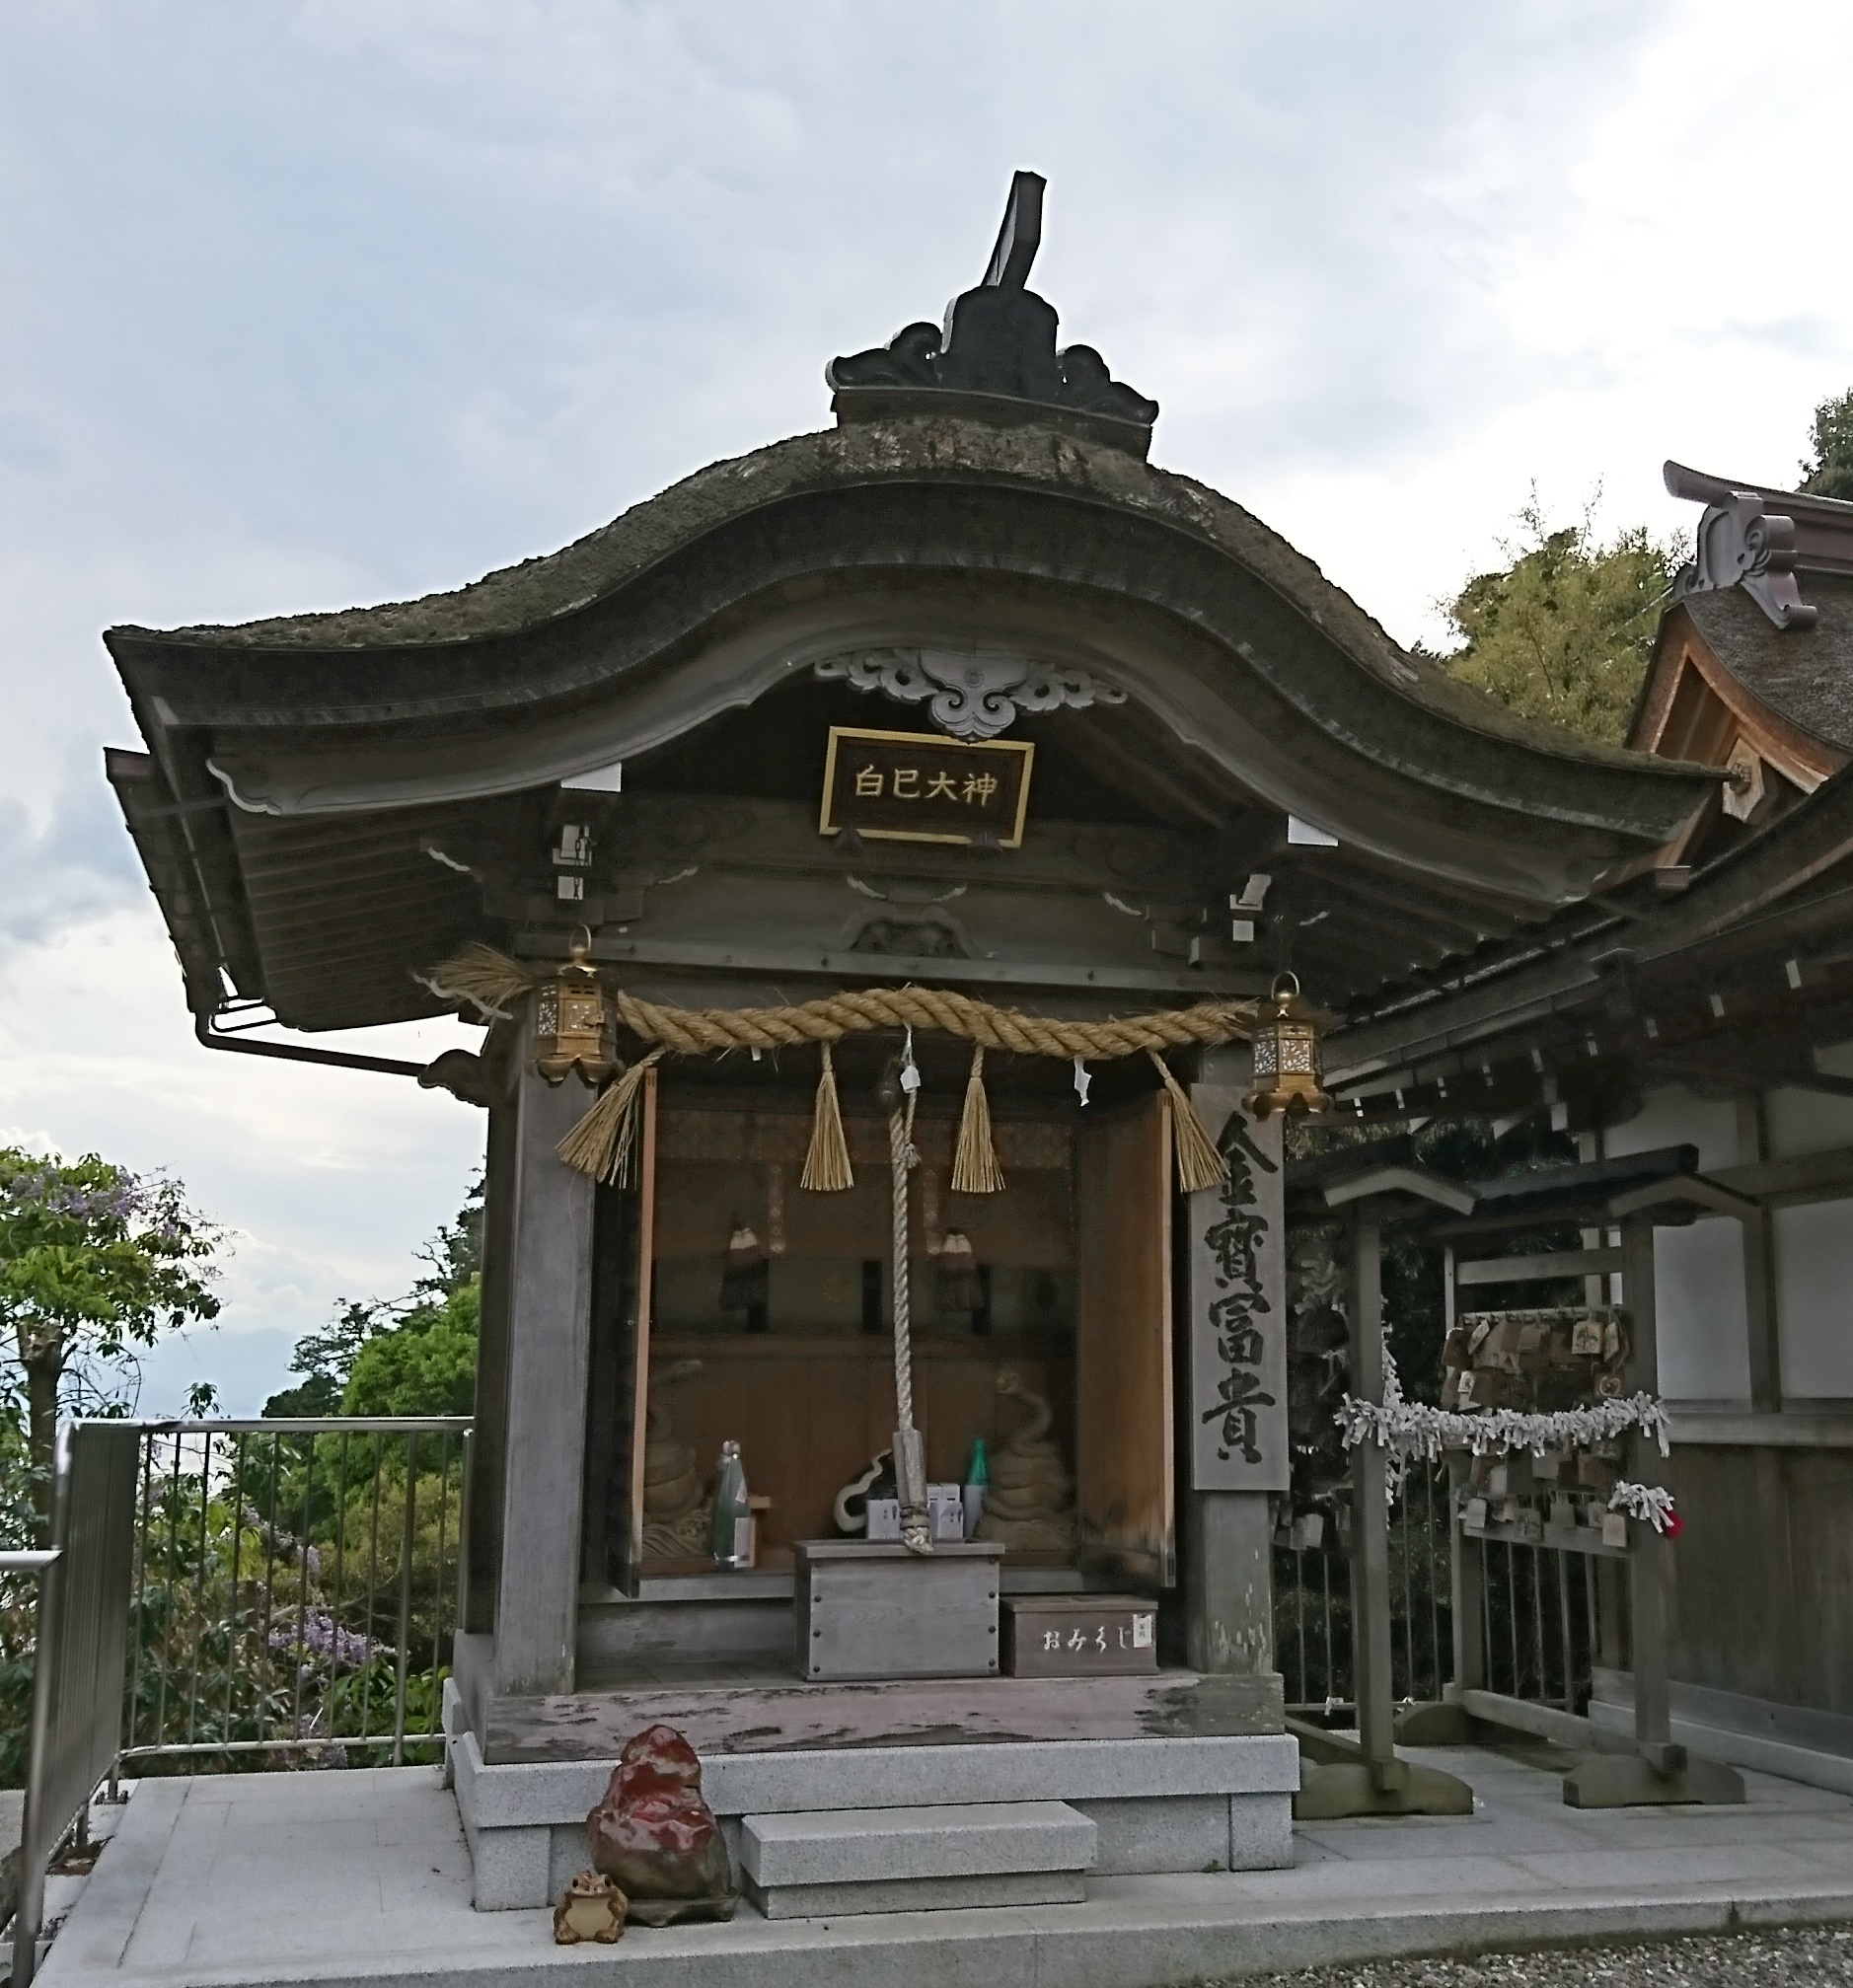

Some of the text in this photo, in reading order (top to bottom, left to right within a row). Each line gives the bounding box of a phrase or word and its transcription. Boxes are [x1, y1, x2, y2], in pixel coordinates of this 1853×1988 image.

[855, 765, 999, 807] 白巳大神
[1044, 1626, 1131, 1653] おみくじ
